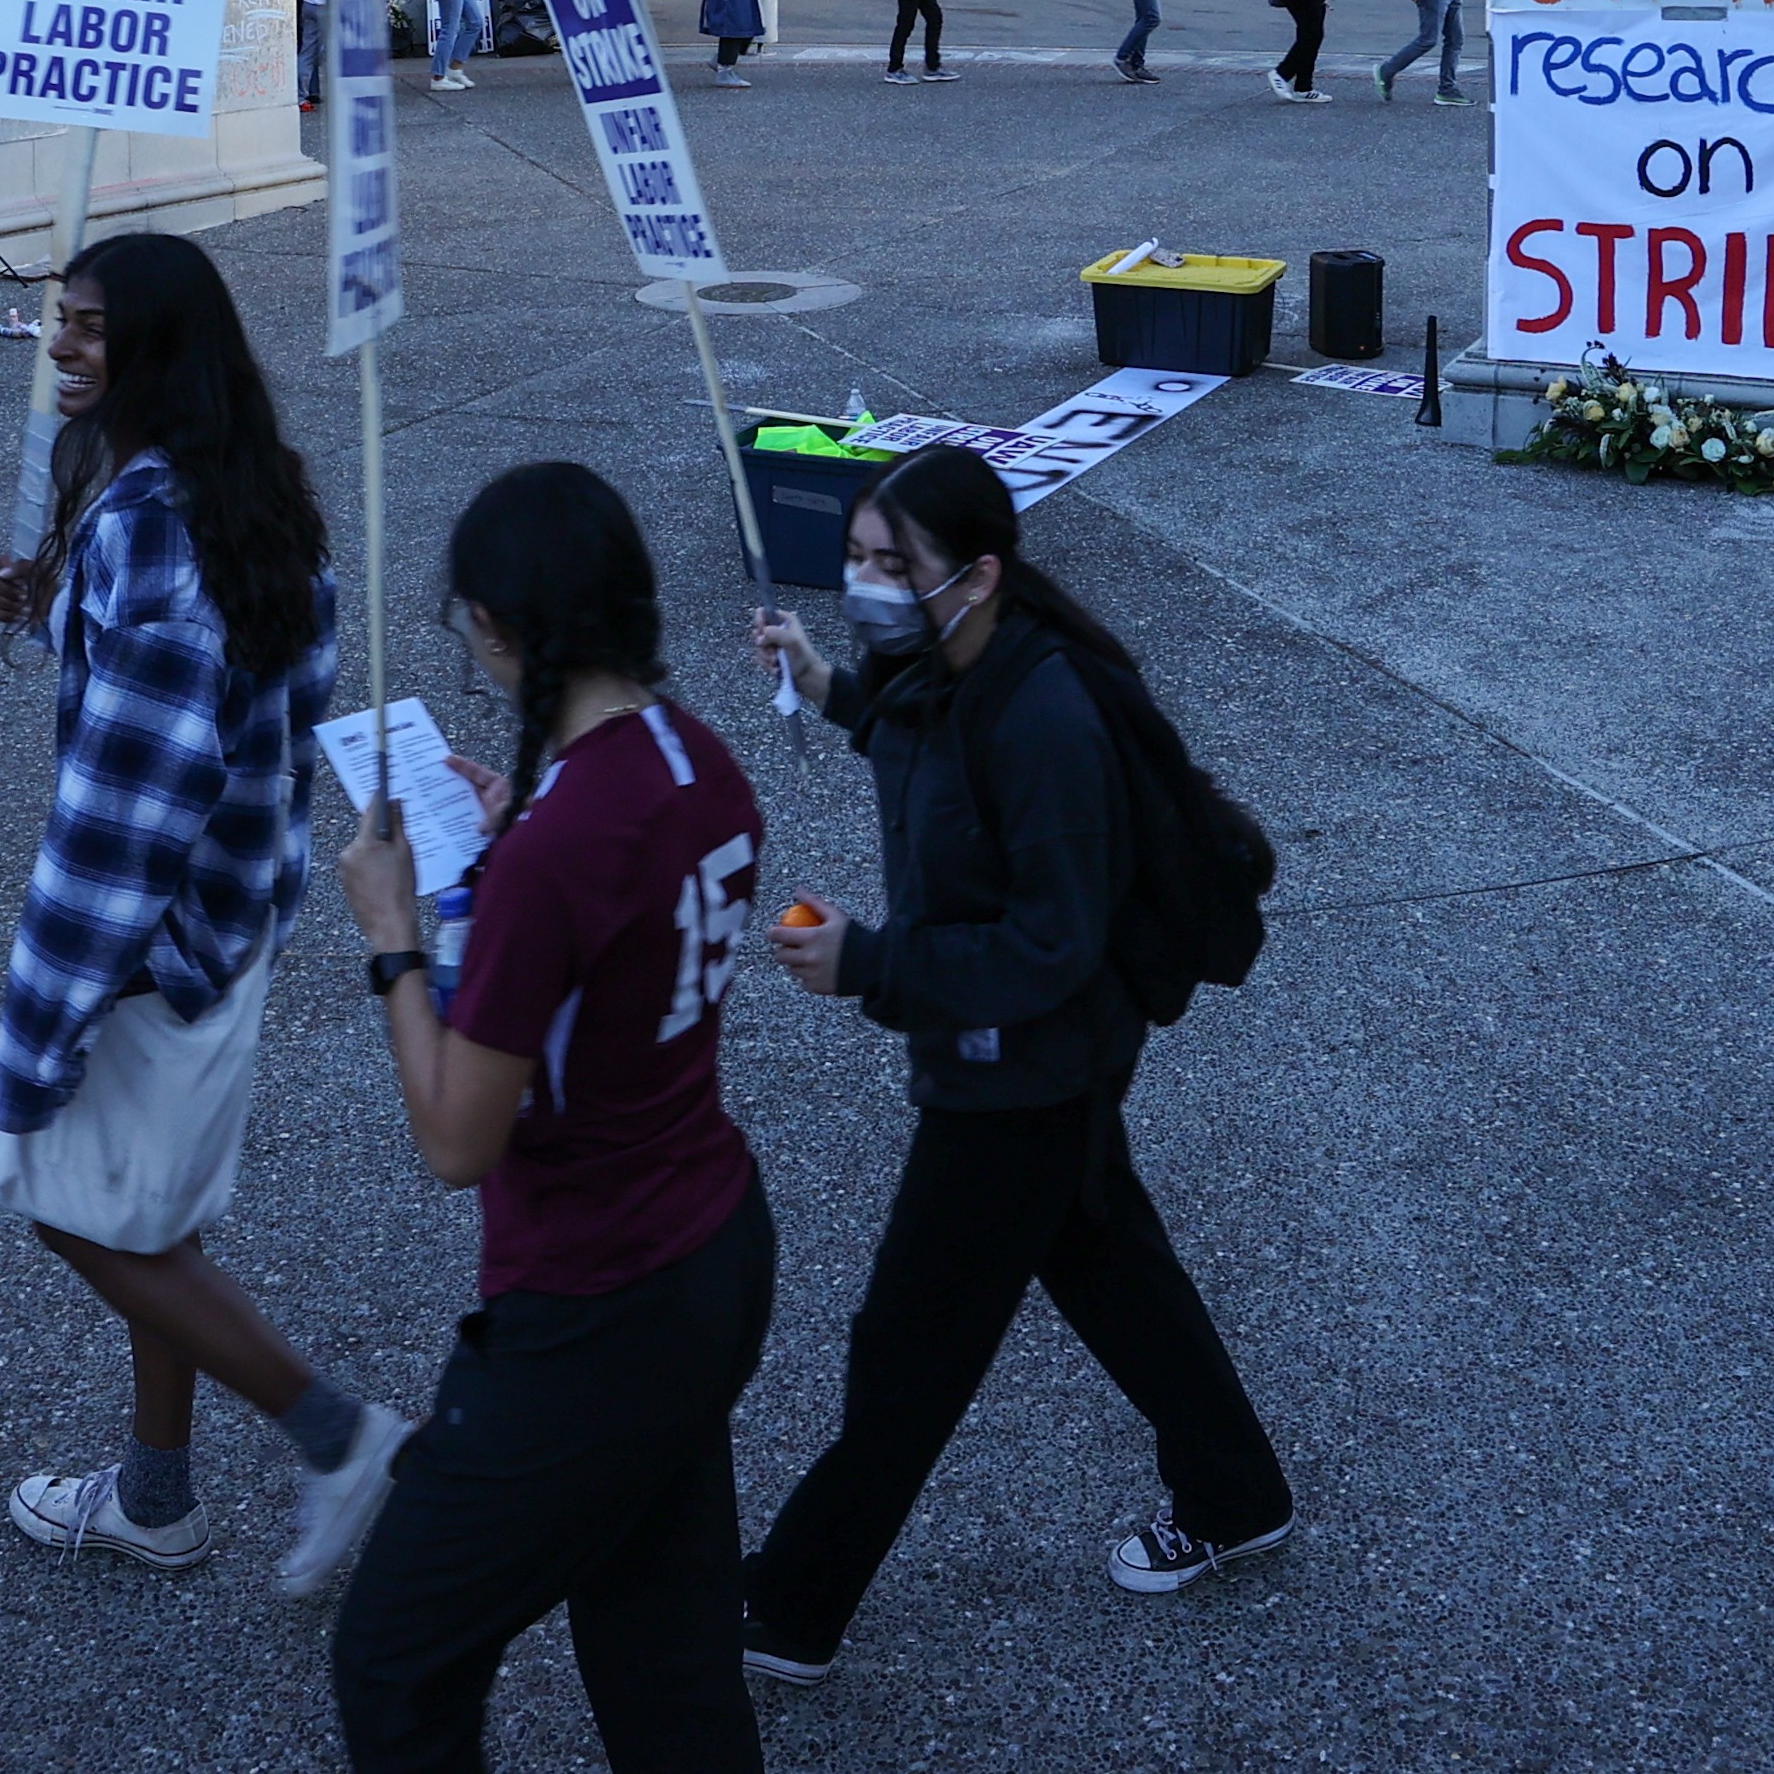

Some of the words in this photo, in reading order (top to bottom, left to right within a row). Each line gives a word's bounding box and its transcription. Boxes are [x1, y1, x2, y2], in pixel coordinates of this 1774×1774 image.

[19, 1, 171, 56] LABOR
[568, 22, 655, 90] STRIKE
[1638, 137, 1753, 197] on
[657, 832, 753, 1042] 15
